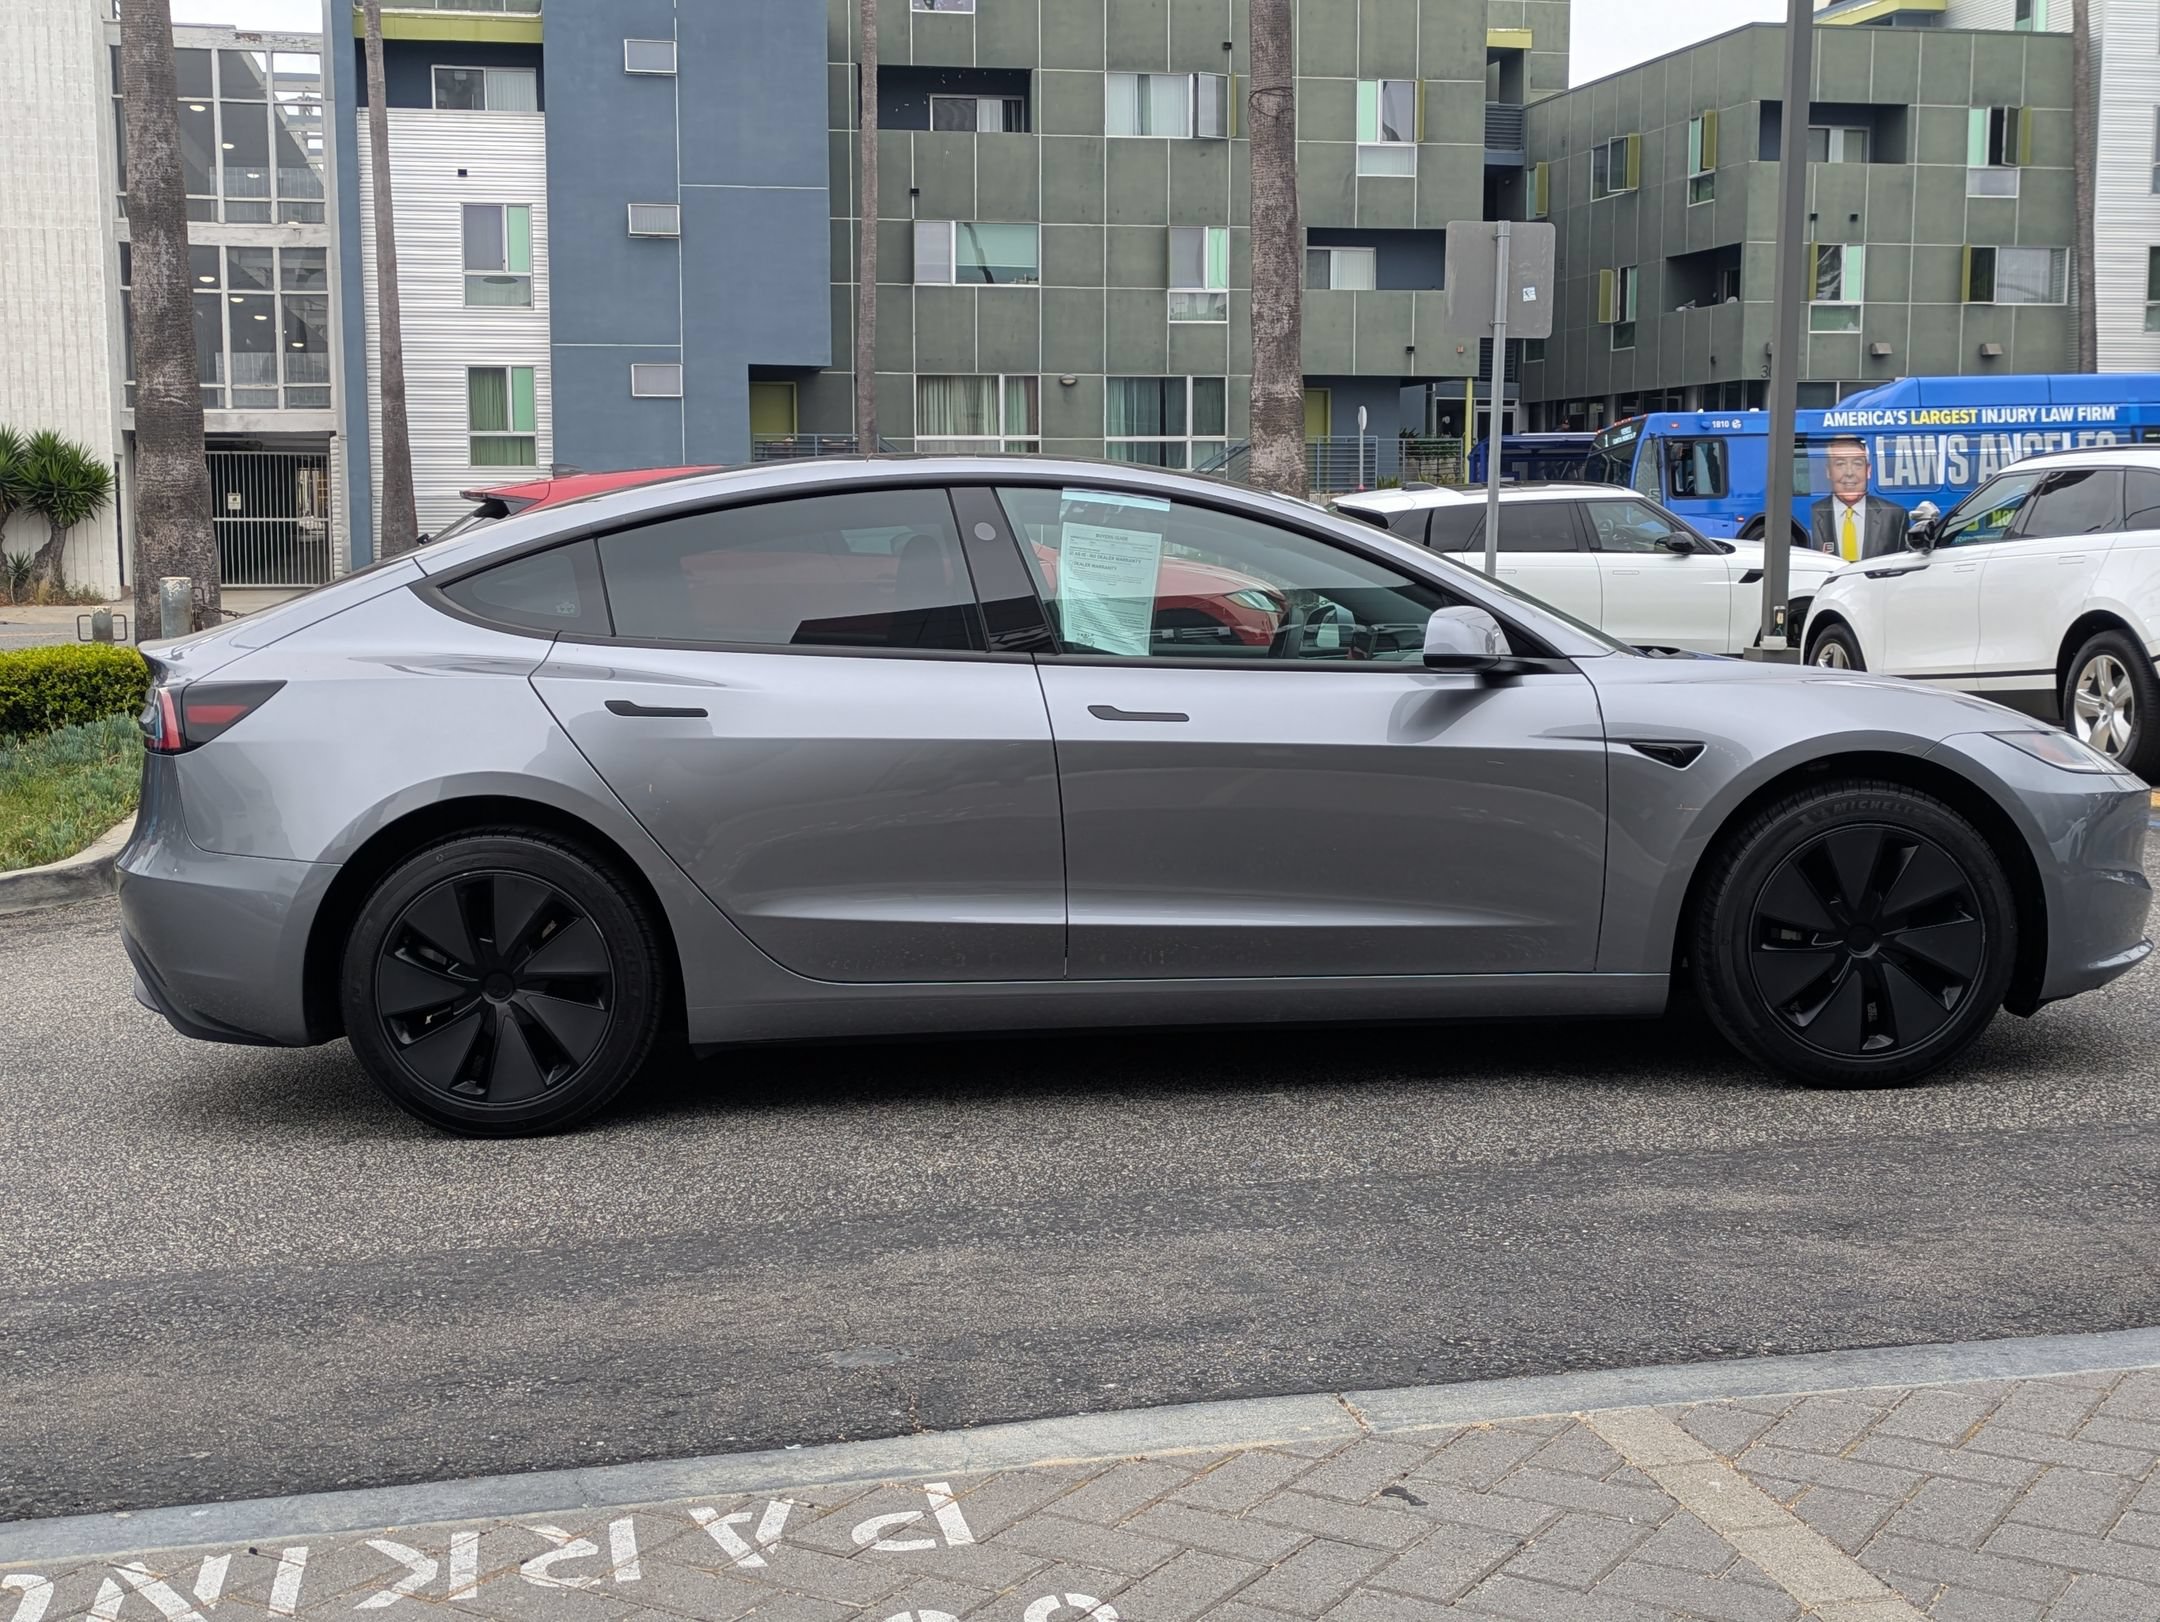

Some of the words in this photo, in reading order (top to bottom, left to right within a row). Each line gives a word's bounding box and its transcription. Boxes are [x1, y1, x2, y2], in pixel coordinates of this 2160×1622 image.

[1711, 419, 1730, 429] 1810
[1823, 410, 1908, 427] AMERICA'S
[1911, 408, 1978, 425] LARGEST
[1981, 407, 2037, 424] INJURY
[2041, 406, 2074, 422] LAW
[2077, 405, 2116, 421] FIRM
[1875, 433, 1970, 487] LAWS
